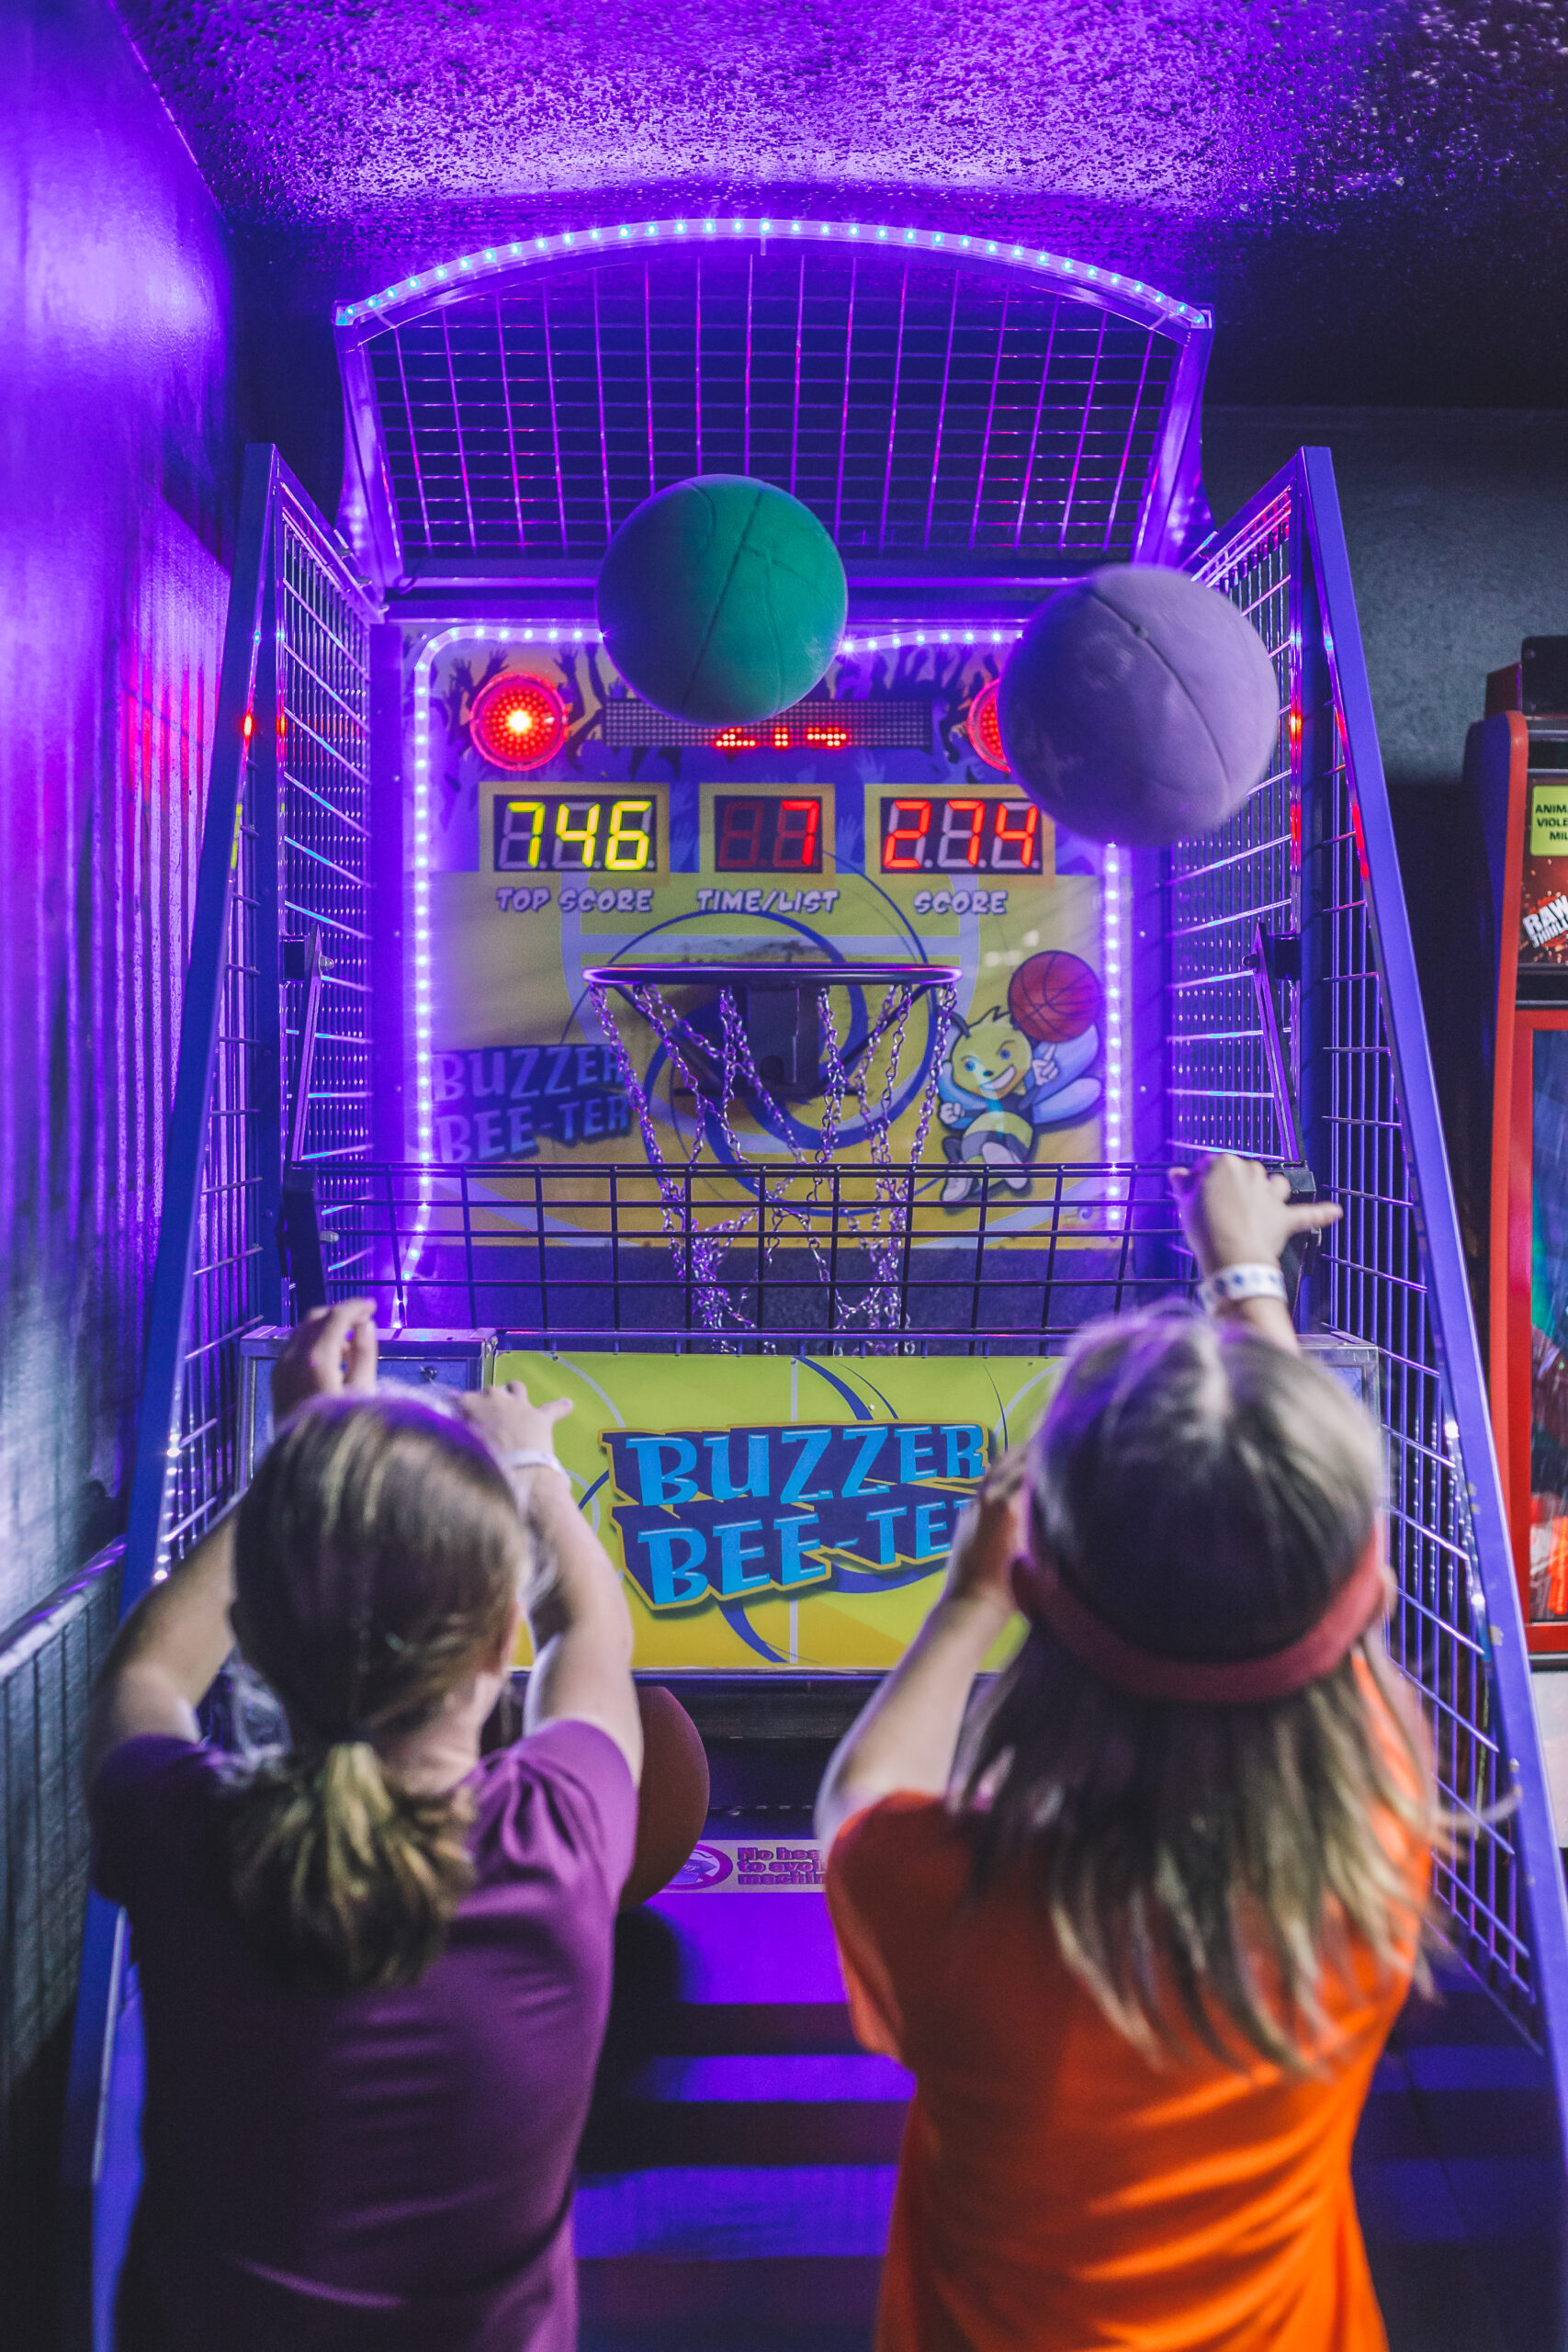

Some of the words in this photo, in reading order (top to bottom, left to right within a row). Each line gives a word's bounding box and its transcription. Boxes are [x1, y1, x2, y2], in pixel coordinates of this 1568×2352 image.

[1535, 804, 1568, 814] ANIM
[507, 800, 652, 870] 746
[883, 799, 1039, 869] 274
[496, 887, 551, 912] TOP
[558, 888, 654, 913] SCORE
[695, 888, 840, 913] TIME/LIST
[913, 889, 1009, 915] SCORE
[432, 1046, 626, 1102] BUZZER
[434, 1095, 628, 1163] BEE-TER
[626, 1424, 986, 1506] BUZZER
[637, 1498, 972, 1606] BEE-TE
[737, 1860, 766, 1872] to
[738, 1847, 773, 1860] No
